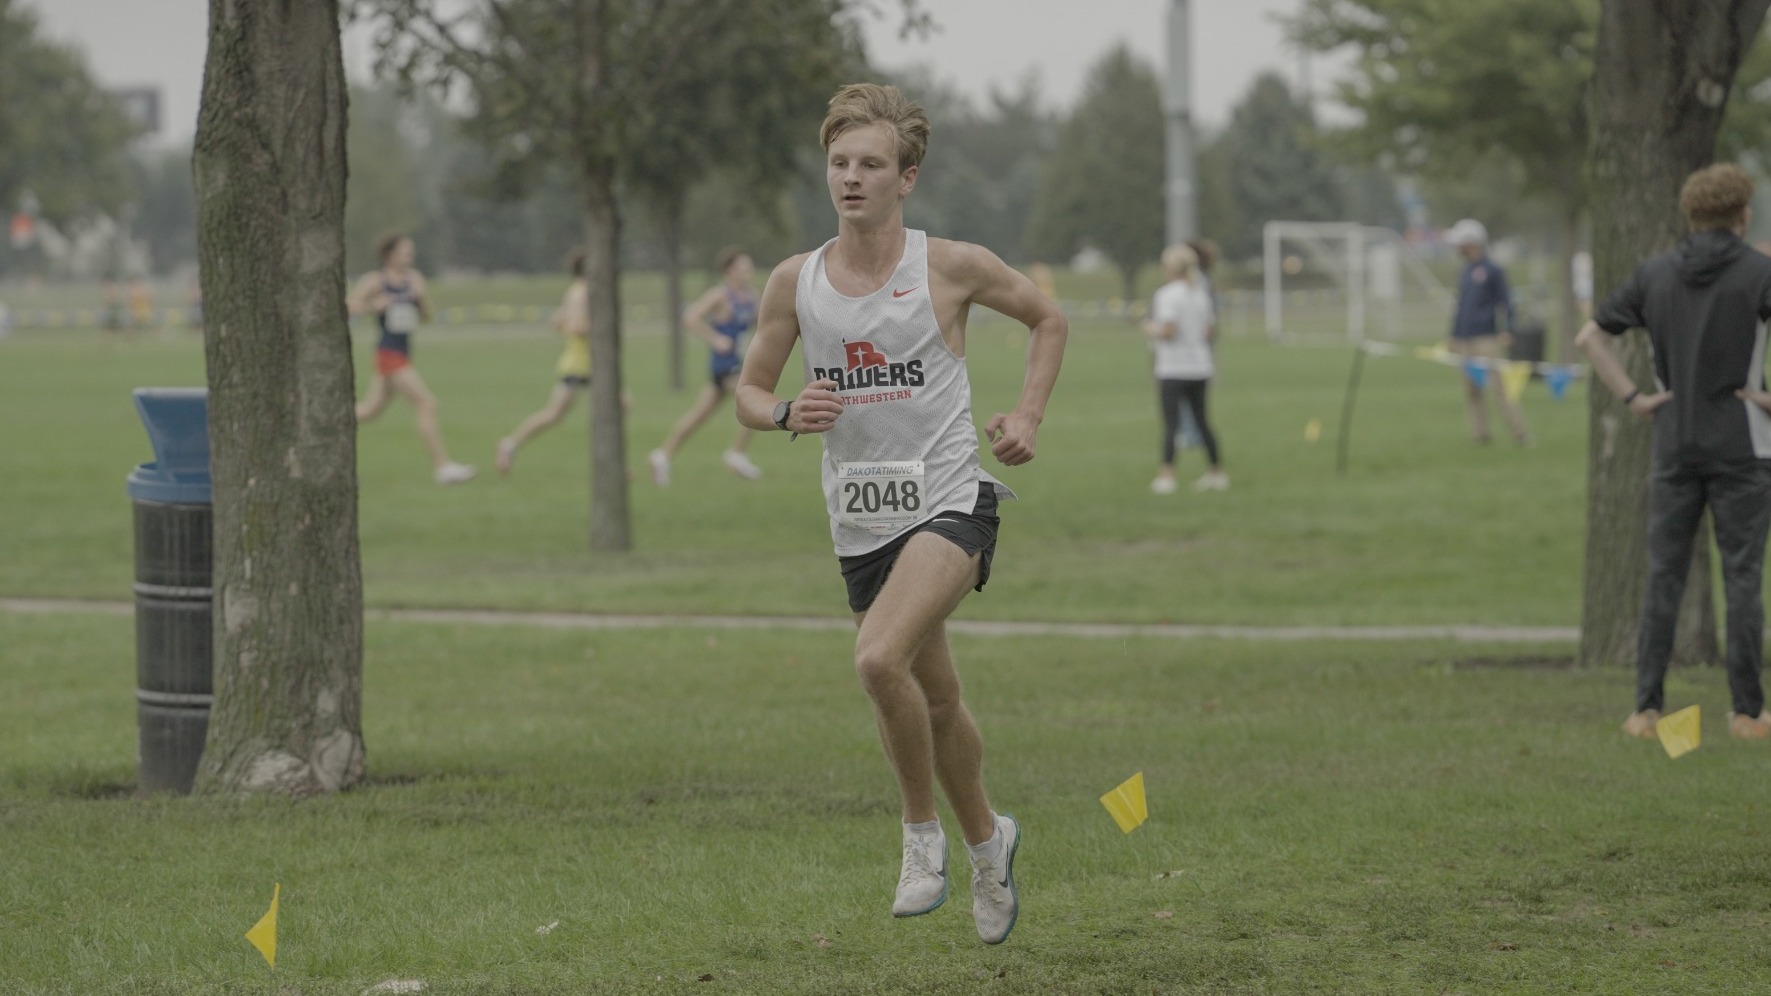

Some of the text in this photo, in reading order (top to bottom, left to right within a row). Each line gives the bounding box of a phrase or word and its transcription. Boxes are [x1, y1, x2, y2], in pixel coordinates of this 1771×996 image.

[841, 389, 912, 405] THWESTERN
[846, 465, 914, 476] DAKOTATIMING
[844, 480, 920, 513] 2048
